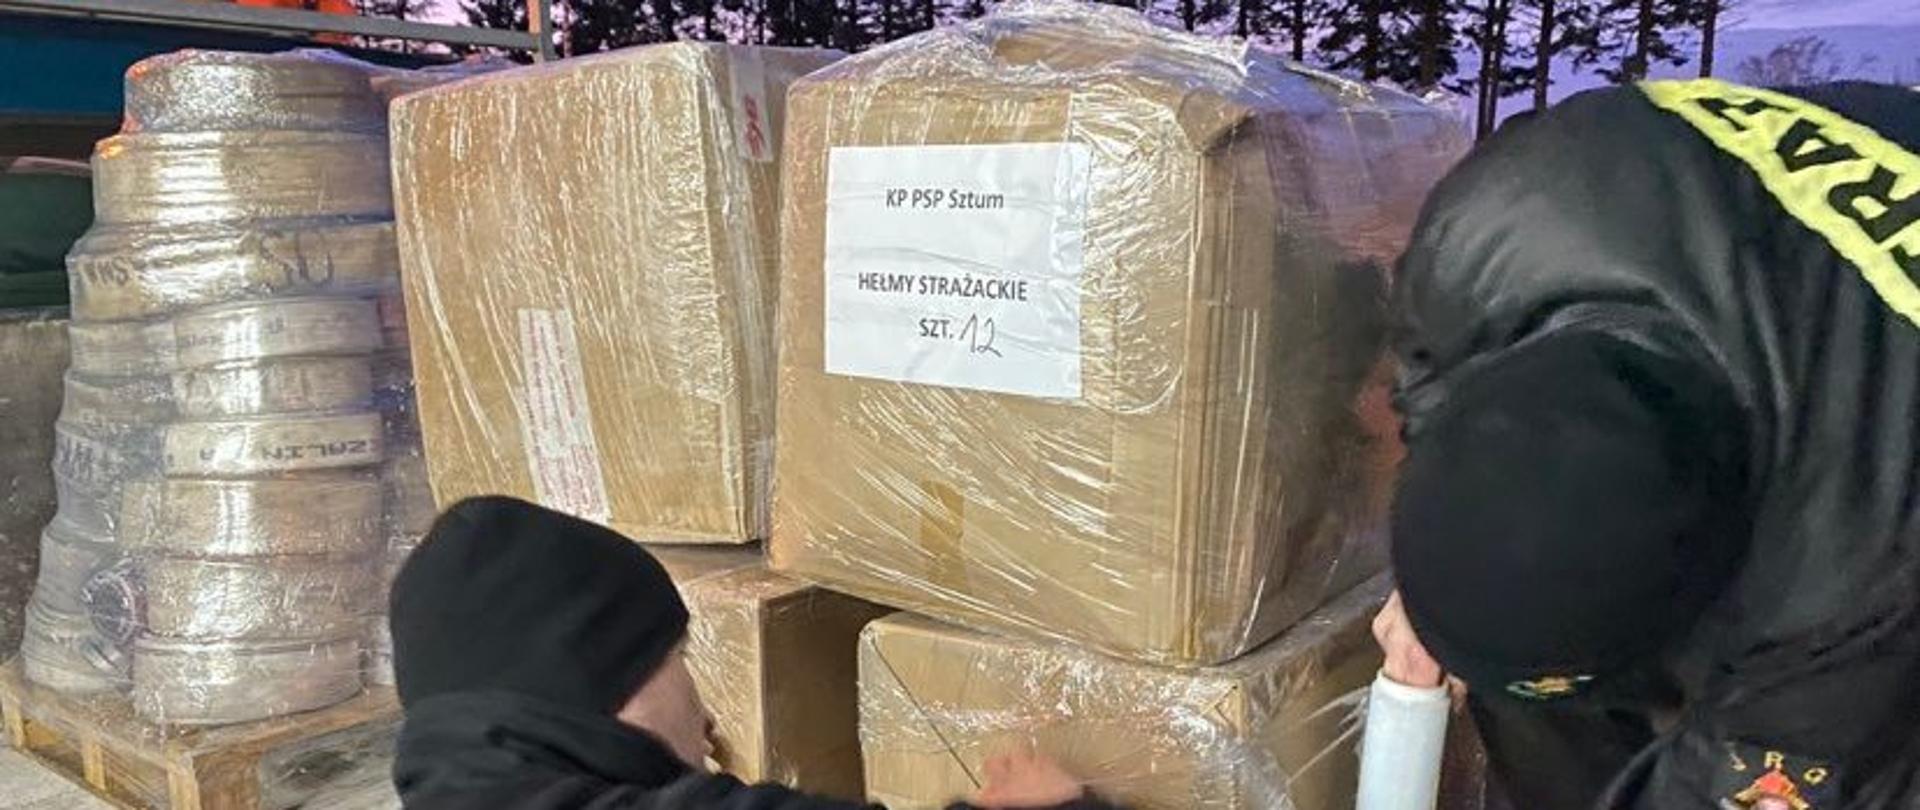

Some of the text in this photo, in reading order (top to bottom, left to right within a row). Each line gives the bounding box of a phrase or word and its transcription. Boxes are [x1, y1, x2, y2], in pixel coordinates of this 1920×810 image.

[886, 188, 1004, 209] KP PSP Sztum
[858, 272, 1028, 301] HEŁMY STRAŻACKIE
[918, 312, 1003, 357] SZT. 12
